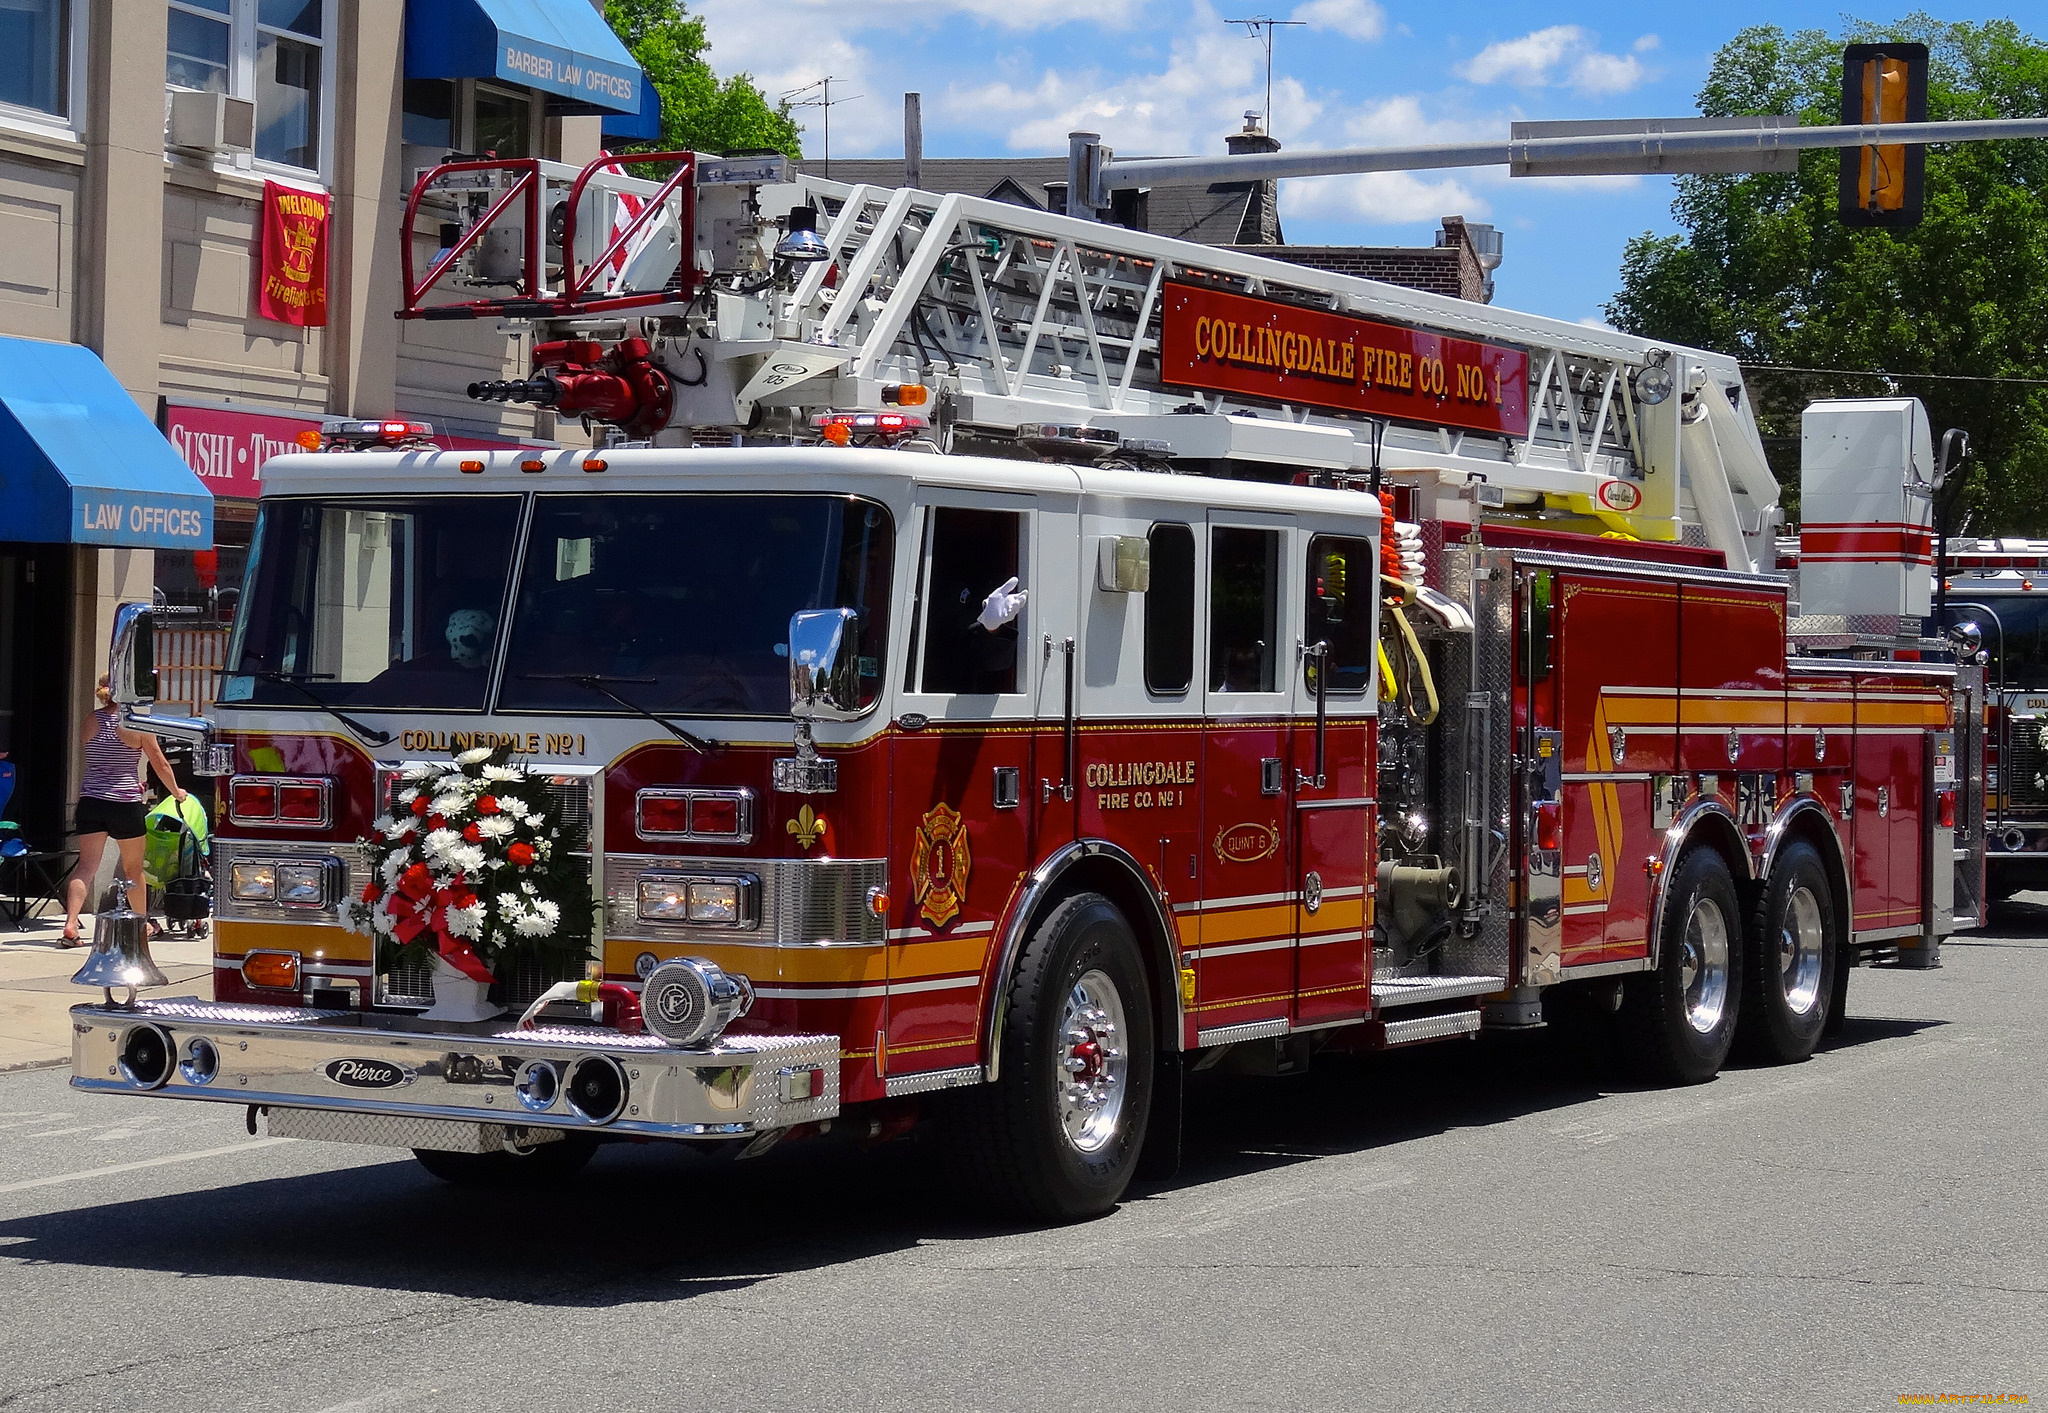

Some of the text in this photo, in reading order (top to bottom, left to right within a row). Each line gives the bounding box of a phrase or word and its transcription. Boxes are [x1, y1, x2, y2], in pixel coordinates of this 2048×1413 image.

[506, 47, 632, 99] BARBER LAW OFFICES
[1195, 315, 1503, 404] COLLINGDALE FIRE CO. NO. 1
[762, 374, 789, 386] 105
[170, 423, 234, 479] SUSHI
[84, 503, 202, 537] LAW OFFICES
[576, 733, 586, 755] 1
[1086, 761, 1195, 787] COLLINGDALE
[1098, 792, 1130, 809] FIRE
[1134, 791, 1154, 808] CO.
[1228, 834, 1266, 853] QUINT 6
[935, 845, 945, 878] 1
[334, 1060, 393, 1082] Pierce
